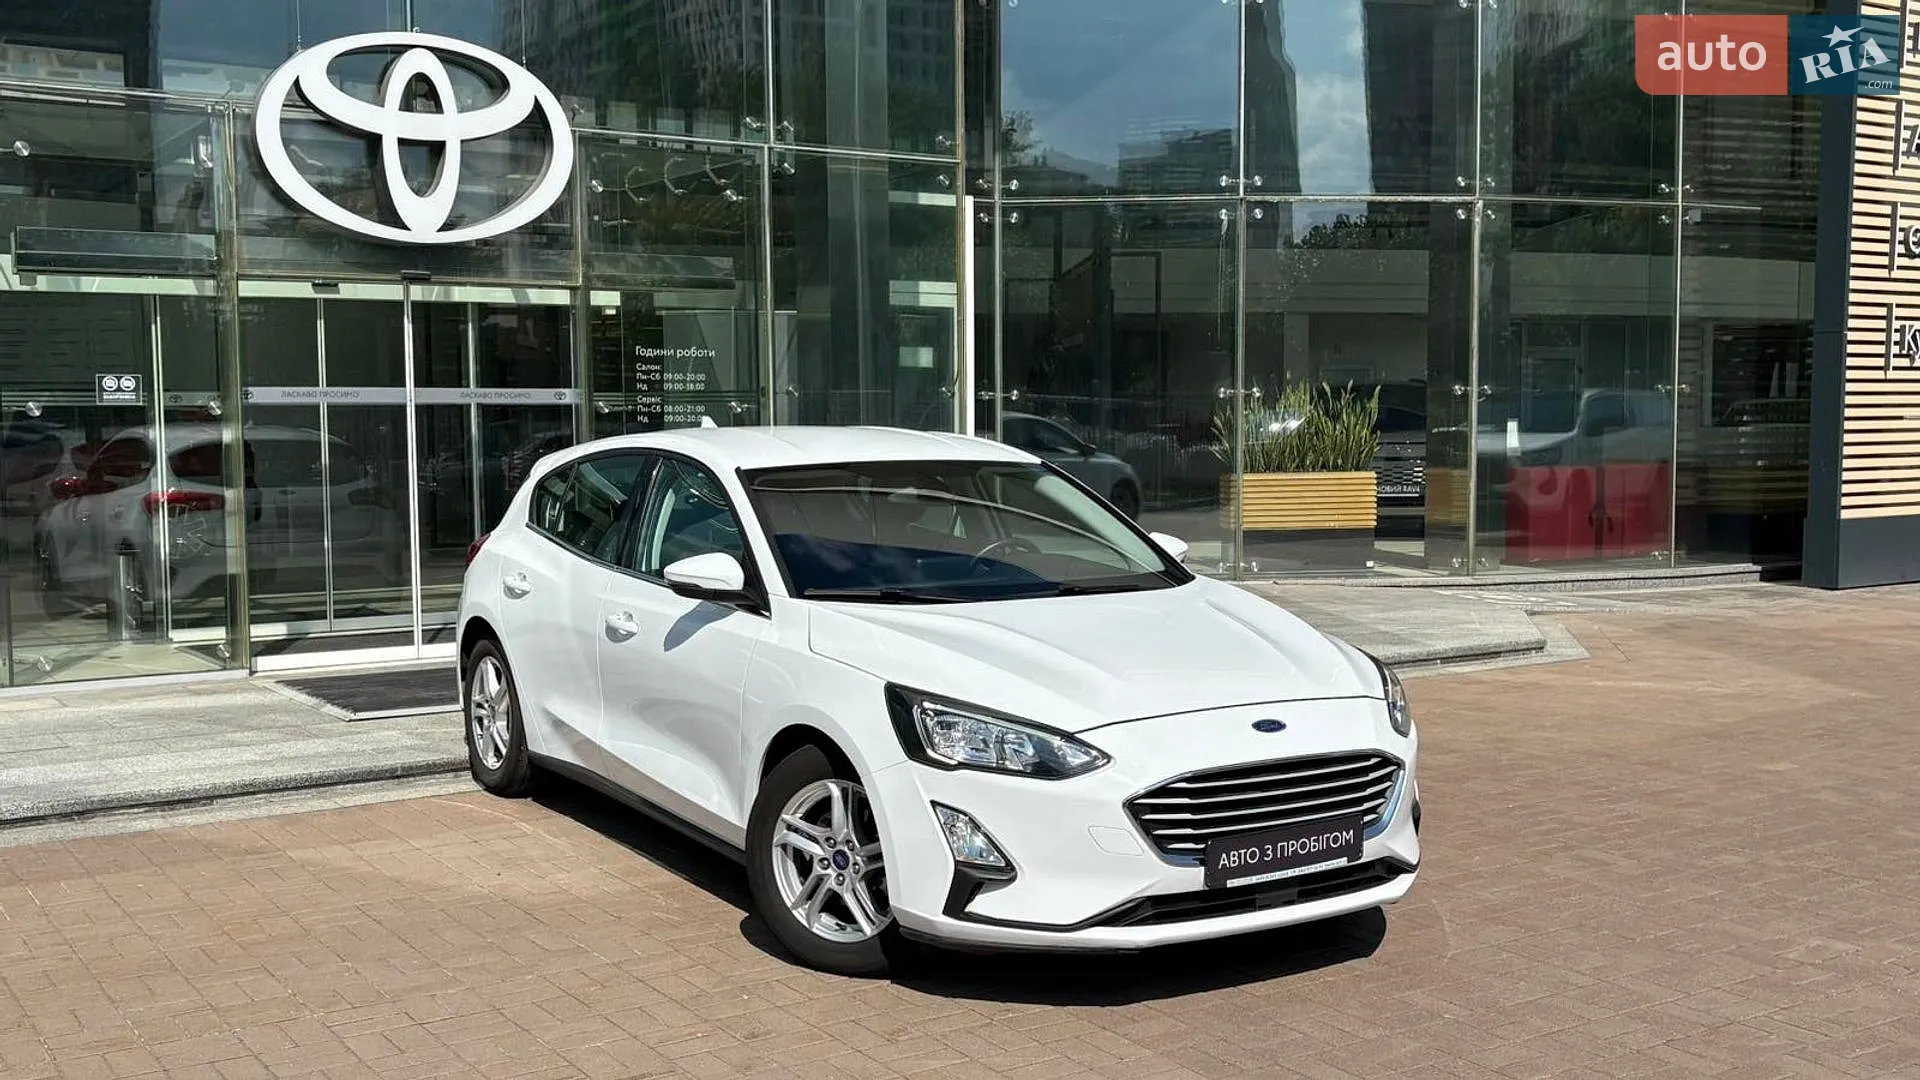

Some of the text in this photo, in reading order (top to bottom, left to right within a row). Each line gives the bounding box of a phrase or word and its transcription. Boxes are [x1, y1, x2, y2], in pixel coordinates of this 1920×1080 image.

[635, 345, 716, 359] Години роботи
[636, 372, 706, 381] Пн-Сб 09:00-20:00
[636, 382, 648, 391] Нд
[637, 404, 662, 413] Пн-Сб
[637, 414, 703, 423] Нд 09:00-20:0
[1218, 847, 1260, 870] АВТО
[1277, 829, 1354, 859] ПРОБІГОМ
